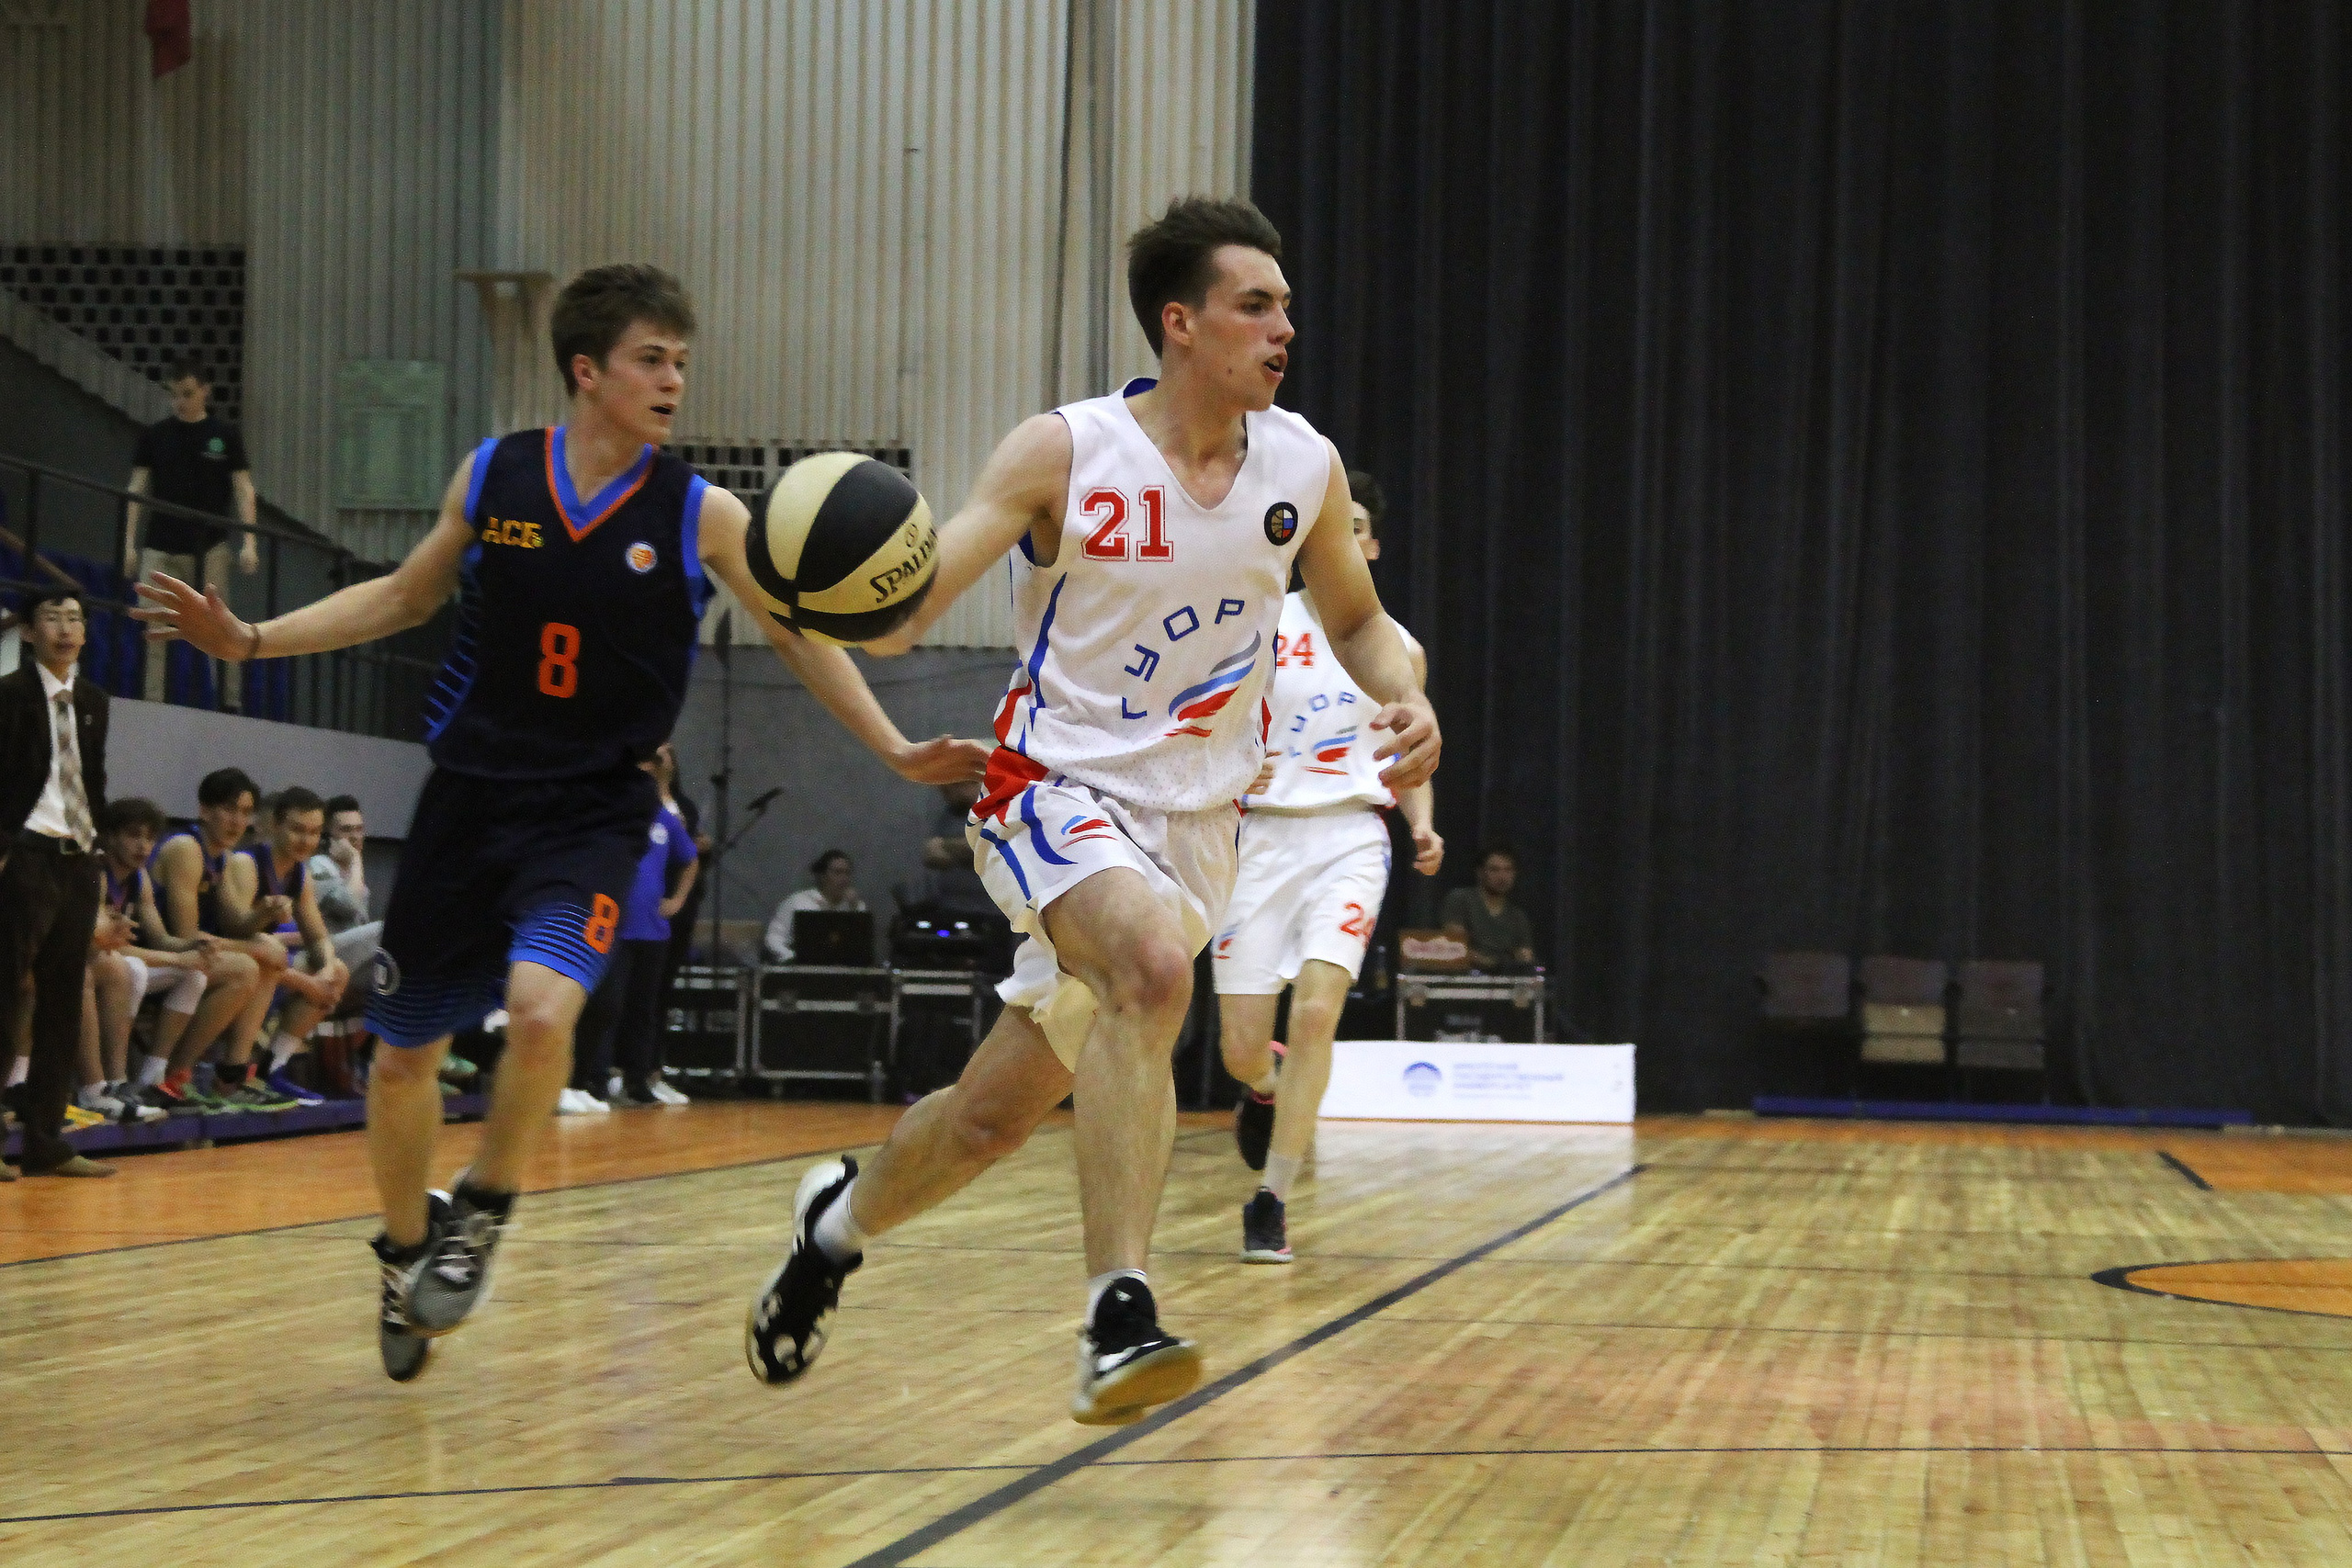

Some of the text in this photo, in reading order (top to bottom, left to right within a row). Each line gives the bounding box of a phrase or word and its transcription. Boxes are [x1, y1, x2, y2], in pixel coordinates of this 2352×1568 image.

[1080, 485, 1174, 562] 21
[537, 622, 581, 698] 8
[583, 893, 619, 954] 8
